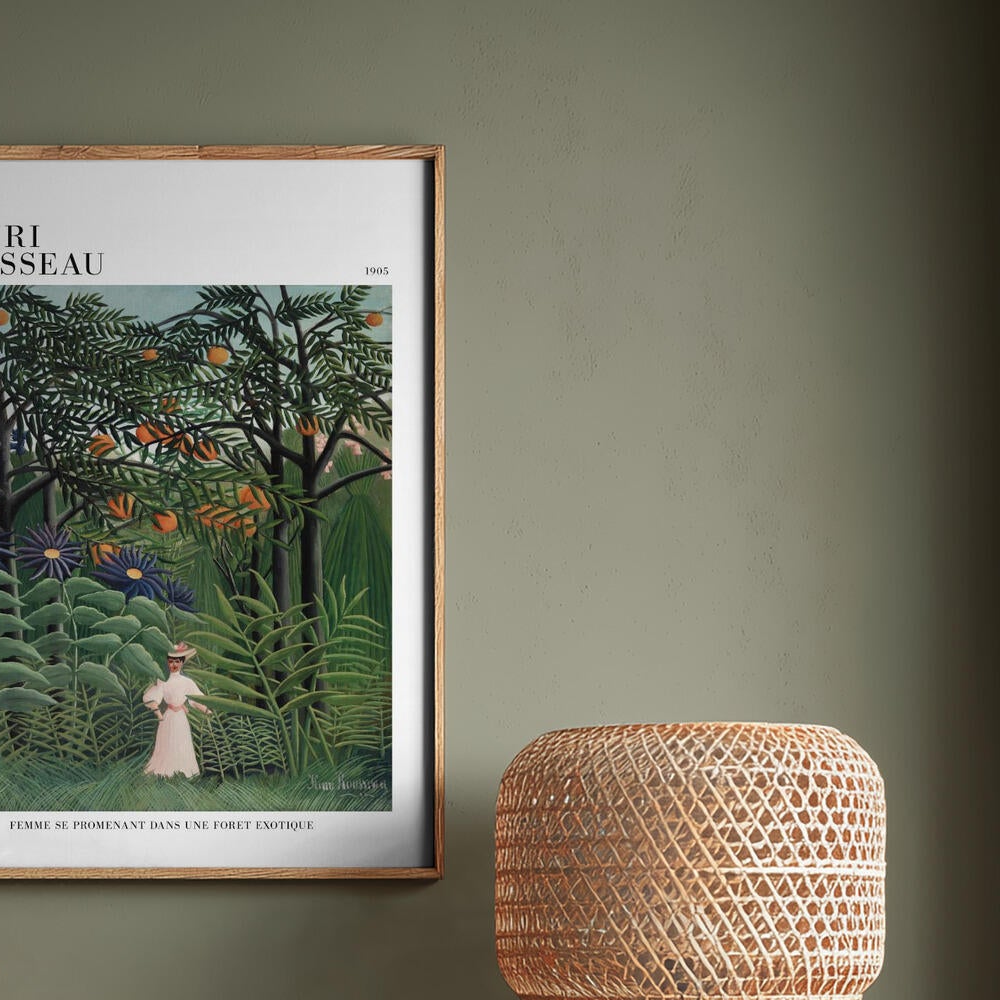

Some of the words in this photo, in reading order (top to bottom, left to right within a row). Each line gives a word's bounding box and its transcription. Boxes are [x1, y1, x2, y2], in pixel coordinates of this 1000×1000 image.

[364, 267, 390, 276] 1905
[9, 820, 51, 830] FEMME
[54, 820, 69, 830] SE
[73, 820, 146, 830] PROMENANT
[150, 820, 181, 830] DANS
[185, 820, 209, 830] UNE
[213, 820, 252, 830] FORET
[256, 820, 315, 832] EXOTIQUE
